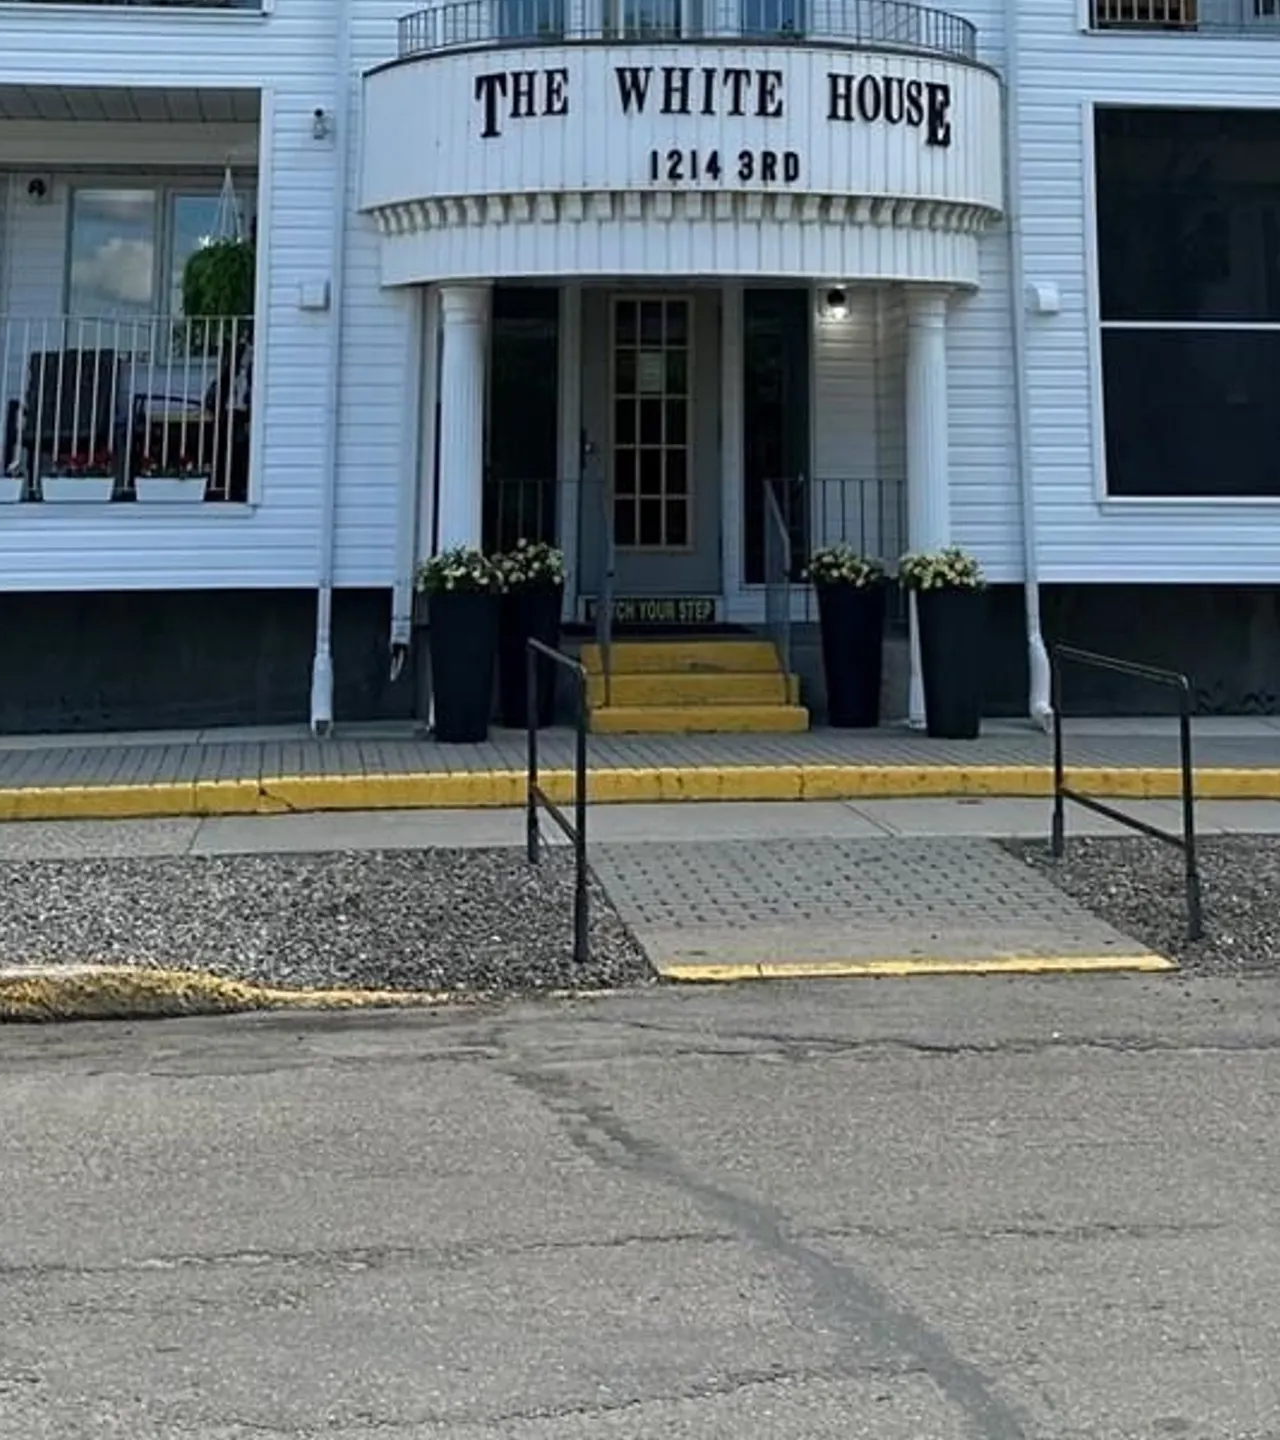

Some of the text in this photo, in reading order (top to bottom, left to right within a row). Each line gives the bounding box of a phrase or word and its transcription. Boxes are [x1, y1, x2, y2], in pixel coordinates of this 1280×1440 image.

[475, 67, 951, 148] THE WHITE HOUSE
[650, 150, 800, 182] 1214 3RD
[639, 599, 675, 621] YOUR
[678, 600, 713, 621] STEP
